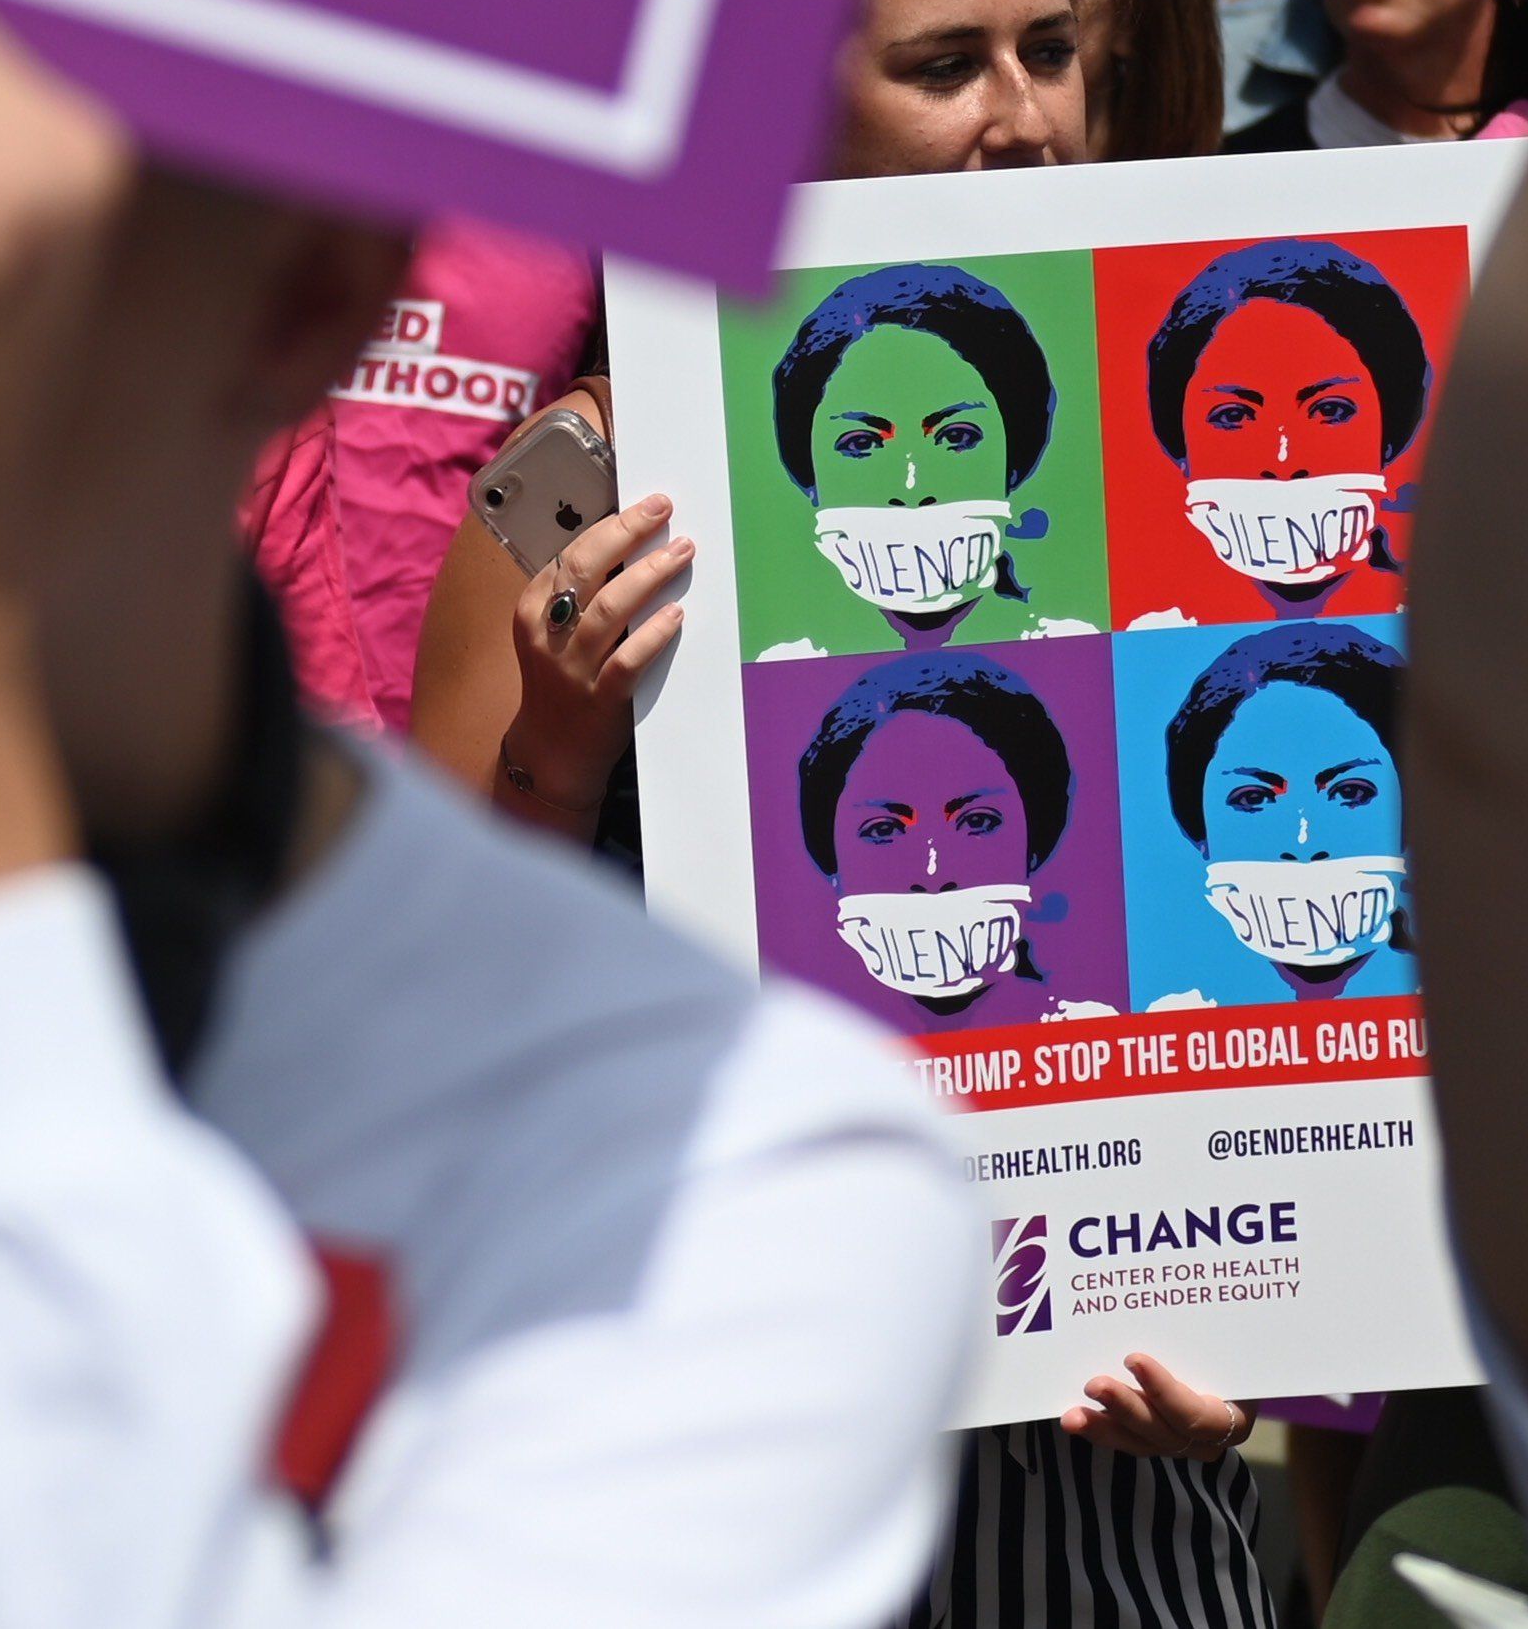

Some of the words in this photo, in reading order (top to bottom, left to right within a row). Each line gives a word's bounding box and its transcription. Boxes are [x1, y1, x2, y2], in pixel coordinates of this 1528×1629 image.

[835, 531, 995, 597] SILENCED
[1205, 504, 1369, 570] SILENCED
[857, 915, 1015, 983] SILENCED
[1225, 886, 1388, 950] SILENCED
[914, 1049, 1027, 1096] TRUMP.
[1033, 1039, 1111, 1087] STOP
[1117, 1033, 1179, 1078] THE
[1186, 1024, 1309, 1072] GLOBAL
[1315, 1020, 1379, 1064] GAG
[1387, 1017, 1429, 1060] RU
[964, 1138, 1142, 1182] DERHEALTH.ORG
[1207, 1119, 1414, 1160] @GENDERHEALTH
[1068, 1201, 1298, 1258] CHANGE
[1070, 1267, 1156, 1292] CENTER
[1161, 1262, 1206, 1283] FOR
[1212, 1256, 1301, 1279] HEALTH
[1072, 1294, 1118, 1316] AND
[1123, 1287, 1213, 1310] GENDER
[1218, 1280, 1301, 1303] EQUITY
